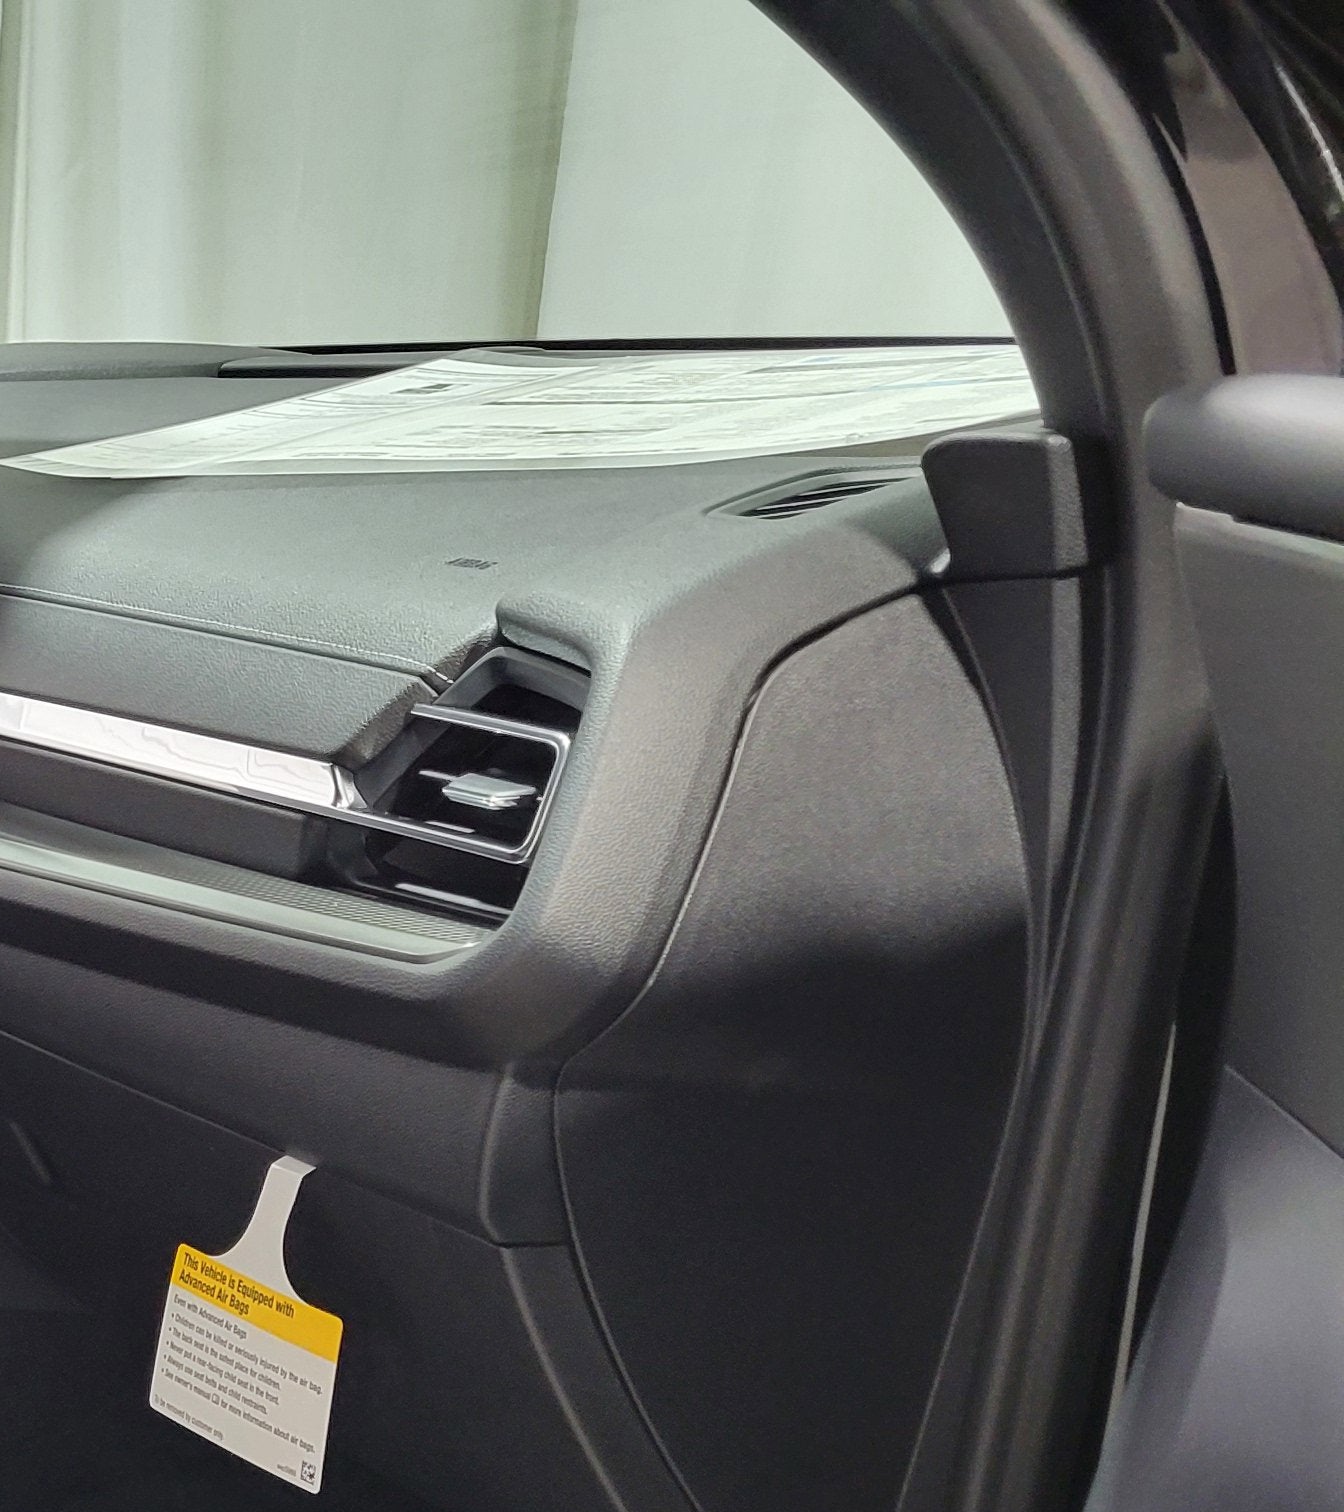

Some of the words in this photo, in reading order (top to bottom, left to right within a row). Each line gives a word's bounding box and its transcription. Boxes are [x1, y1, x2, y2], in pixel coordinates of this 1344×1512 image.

[179, 1269, 216, 1297] Advanced
[216, 1288, 229, 1304] Air
[229, 1294, 249, 1315] Bags
[184, 1252, 199, 1271] This
[200, 1261, 227, 1285] Vehicle
[228, 1274, 236, 1290] is
[237, 1279, 274, 1308] Equipped
[276, 1301, 294, 1318] with
[174, 1293, 186, 1307] Even
[187, 1303, 198, 1313] with
[199, 1307, 224, 1327] Advanced
[224, 1320, 233, 1331] Air
[233, 1324, 247, 1339] Bags
[167, 1355, 184, 1370] Always
[194, 1371, 205, 1382] seat
[205, 1375, 217, 1388] belts
[218, 1383, 228, 1394] and
[228, 1389, 241, 1401] child
[170, 1341, 184, 1354] Never
[183, 1350, 192, 1360] put
[197, 1357, 223, 1378] rear-facing
[224, 1371, 237, 1383] child
[237, 1378, 249, 1389] seat
[249, 1384, 254, 1392] in
[255, 1386, 264, 1397] the
[173, 1327, 181, 1338] The
[181, 1332, 193, 1345] back
[194, 1340, 204, 1351] seat
[204, 1345, 209, 1354] is
[210, 1347, 218, 1358] the
[234, 1362, 249, 1374] place
[250, 1368, 258, 1378] for
[175, 1313, 195, 1330] Children
[195, 1326, 205, 1336] can
[205, 1329, 212, 1340] be
[213, 1334, 228, 1348] killed
[228, 1343, 234, 1351] or
[235, 1346, 258, 1365] seriously
[259, 1358, 279, 1374] injured
[280, 1367, 287, 1379] by
[289, 1372, 298, 1383] the
[299, 1378, 308, 1387] air
[309, 1381, 322, 1395] bag.
[165, 1368, 174, 1380] See
[220, 1399, 228, 1409] for
[228, 1405, 241, 1417] more
[243, 1411, 272, 1432] information
[273, 1428, 290, 1441] about
[290, 1436, 299, 1445] air
